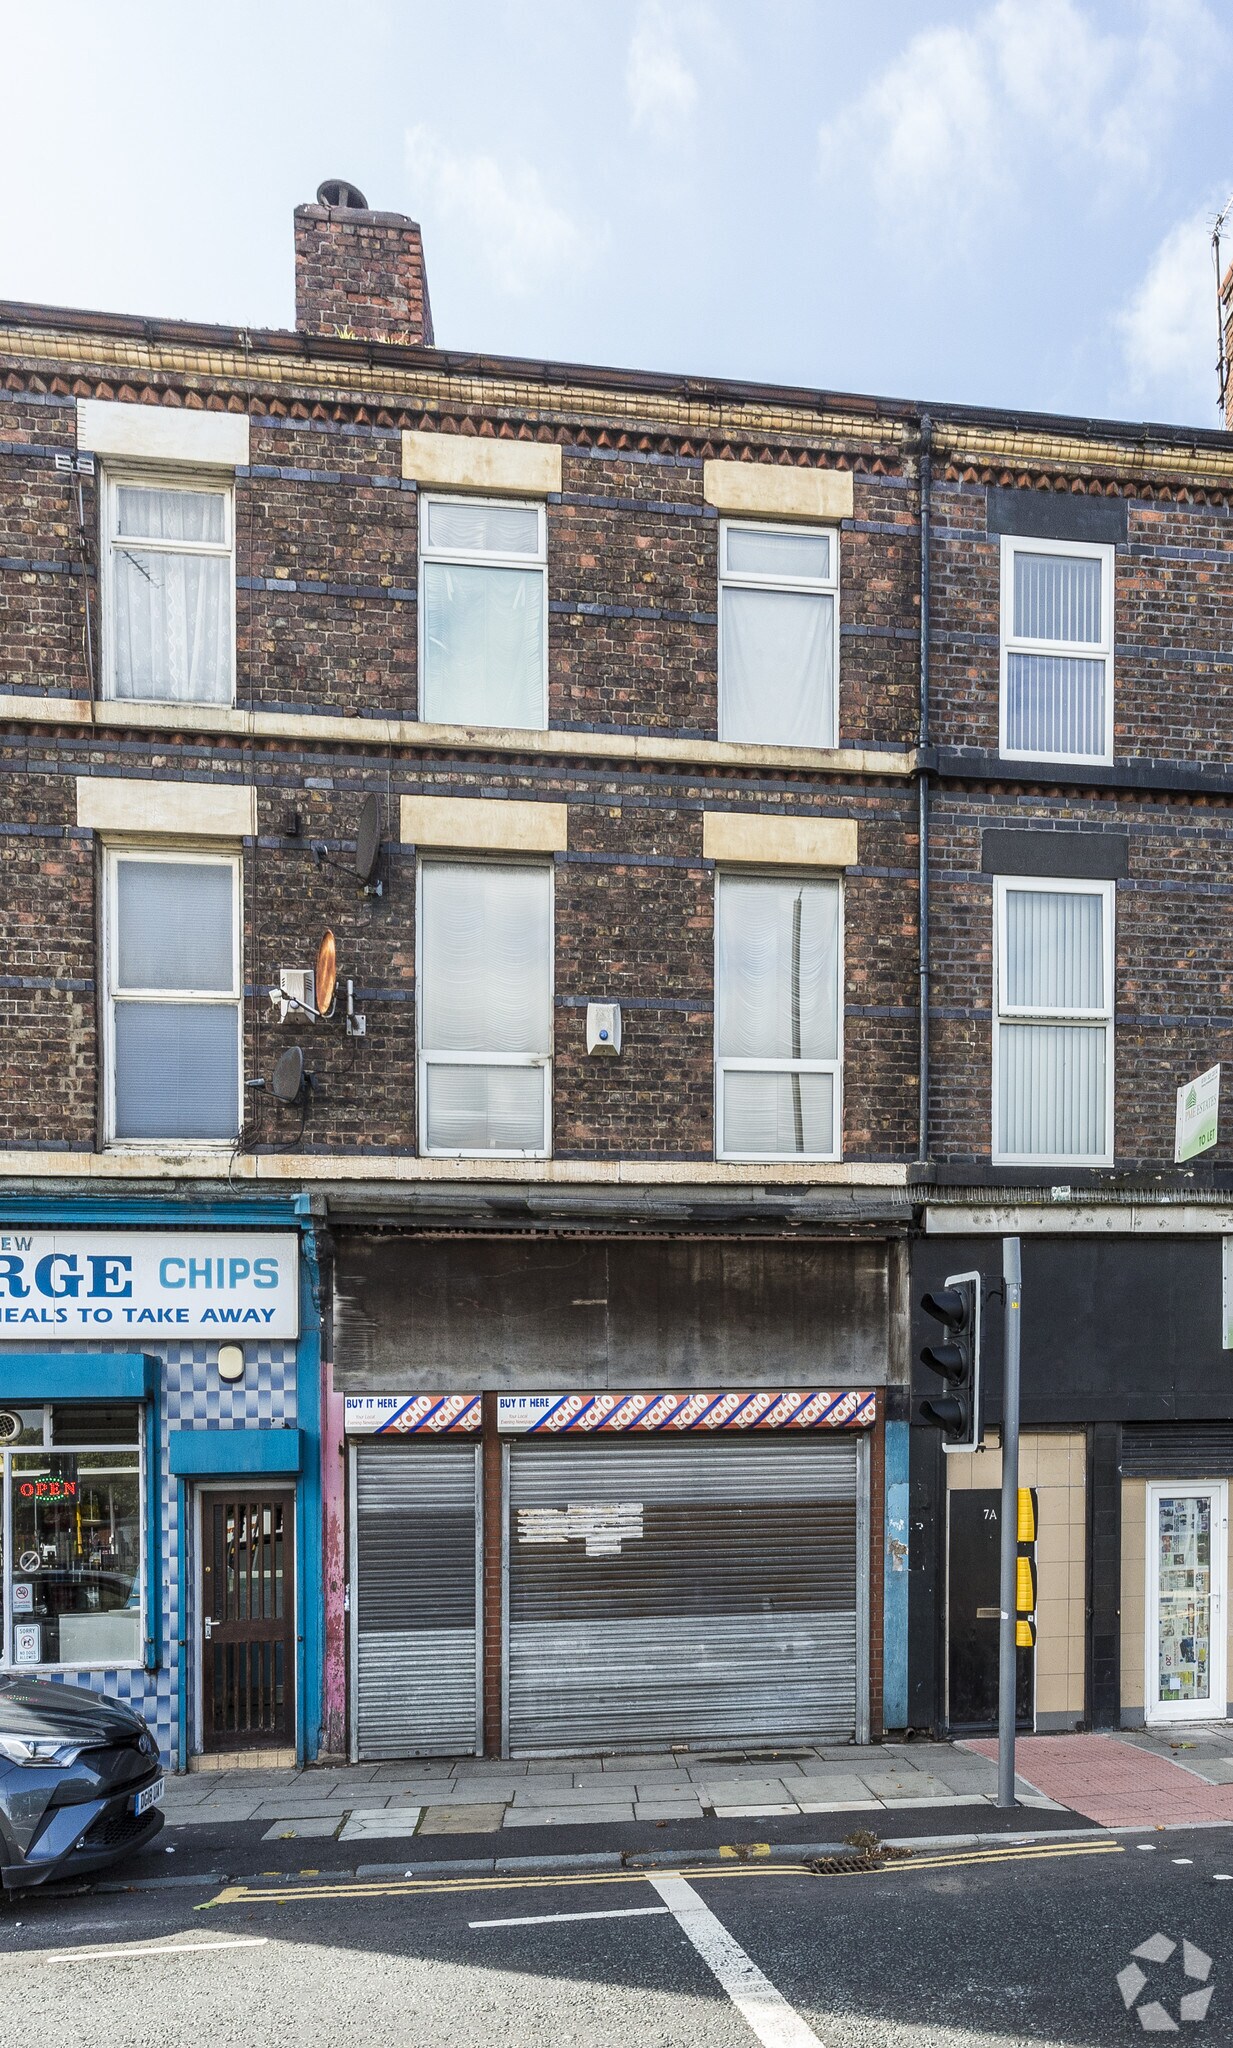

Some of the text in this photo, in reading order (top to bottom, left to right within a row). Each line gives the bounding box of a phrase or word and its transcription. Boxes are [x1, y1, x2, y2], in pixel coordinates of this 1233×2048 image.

[1197, 1096, 1217, 1116] ESTATES
[1199, 1128, 1215, 1147] TO LET
[159, 1257, 279, 1289] CHIPS
[0, 1307, 276, 1323] EALS TO TAKE AWAY
[346, 1398, 397, 1408] BUY IT HERE
[393, 1396, 432, 1433] ECHO
[427, 1395, 464, 1432] ECHO
[500, 1398, 549, 1408] BUY IT HERE
[545, 1396, 582, 1432] ECHO
[577, 1395, 614, 1431] ECHO
[609, 1395, 646, 1431] ECHO
[641, 1395, 677, 1430] ECHO
[673, 1394, 709, 1430] ECHO
[704, 1394, 740, 1430] ECHO
[735, 1393, 770, 1429] ECHO
[766, 1393, 800, 1428] ECHO
[796, 1392, 831, 1428] ECHO
[826, 1392, 861, 1427] ECHO
[20, 1482, 76, 1496] OPEN
[983, 1509, 997, 1520] 7A
